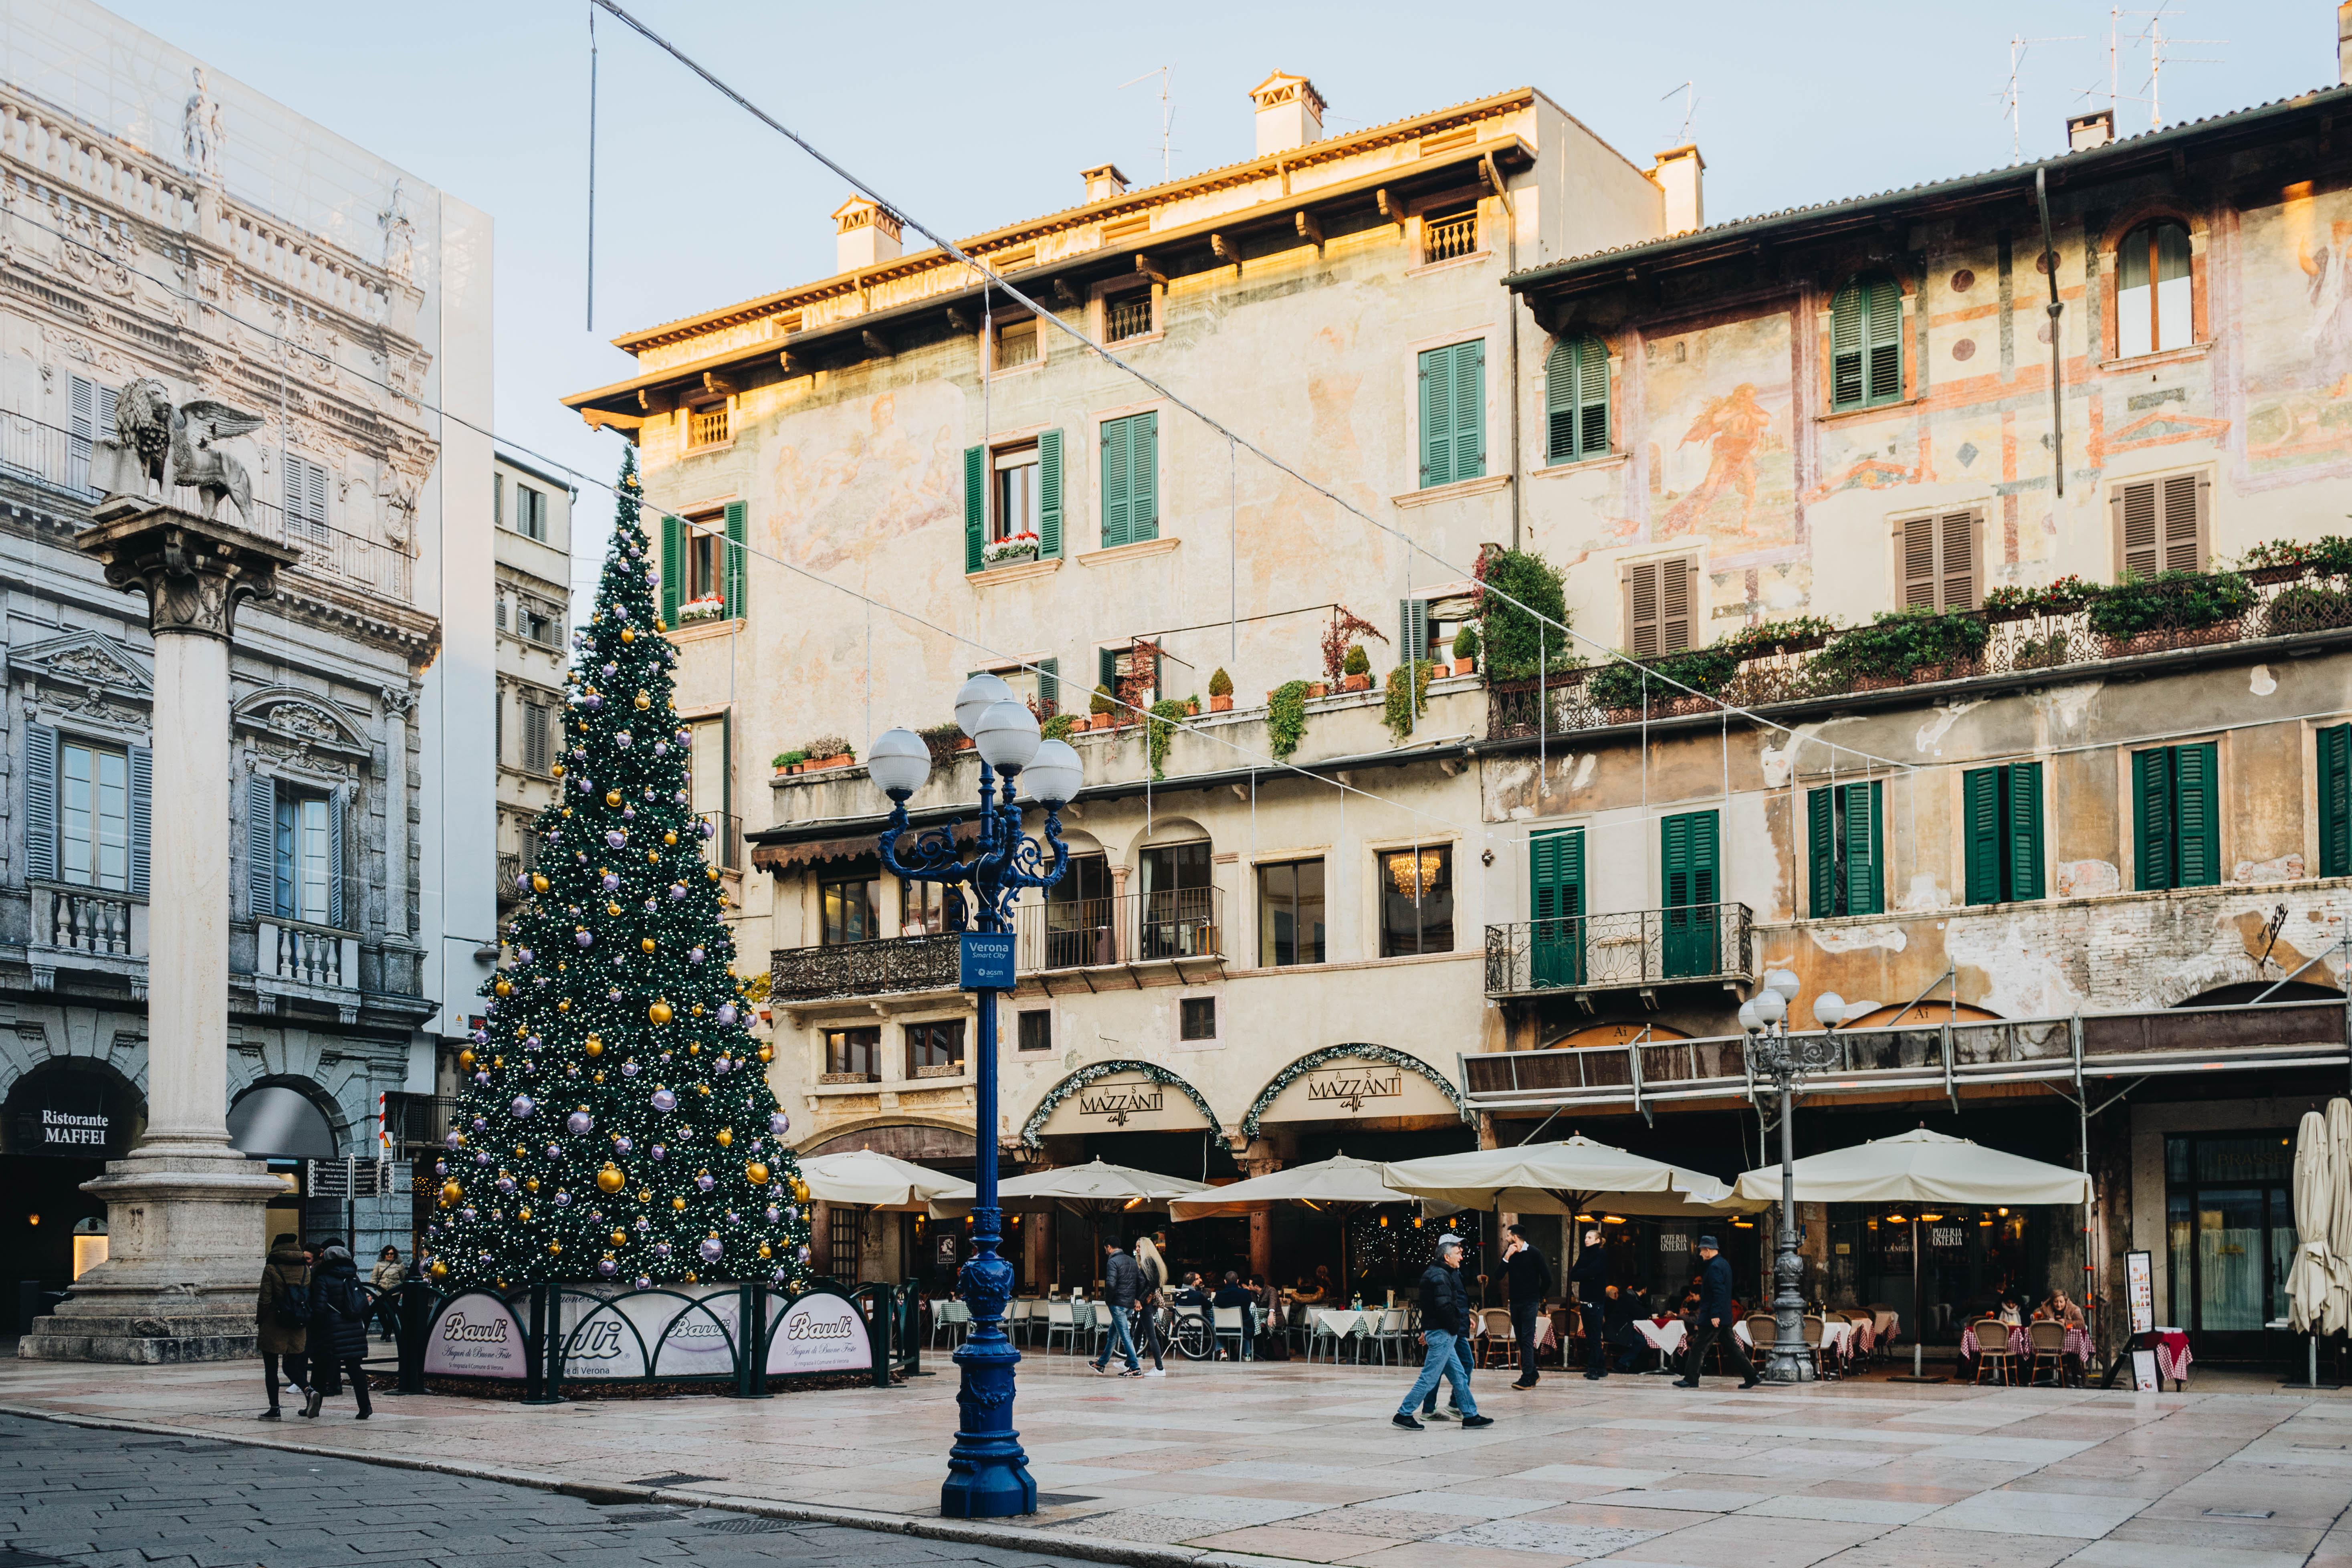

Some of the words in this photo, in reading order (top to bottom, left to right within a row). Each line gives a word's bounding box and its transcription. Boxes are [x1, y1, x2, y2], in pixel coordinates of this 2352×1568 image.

[969, 942, 1009, 952] Verona
[1914, 1007, 1929, 1019] Ai
[1613, 1026, 1627, 1037] Ai
[1308, 1068, 1401, 1082] CASA
[1079, 1084, 1163, 1097] CASA
[1308, 1078, 1401, 1098] MAZZANTI
[1080, 1093, 1163, 1112] MAZZANTI
[42, 1110, 109, 1126] Ristorante
[45, 1127, 106, 1145] MAFFEI
[1660, 1234, 1687, 1243] PIZZERIA
[1933, 1228, 1962, 1237] PIZZERIA
[1660, 1242, 1687, 1251] OSTERIA
[1933, 1236, 1962, 1246] OSTERIA
[443, 1312, 508, 1343] Bauli
[787, 1312, 852, 1340] Bauli
[442, 1344, 465, 1361] Auguri
[465, 1348, 472, 1357] di
[472, 1346, 495, 1358] Buone
[495, 1347, 512, 1359] Feste
[786, 1343, 810, 1359] Auguri
[818, 1343, 840, 1354] Buone
[840, 1342, 856, 1353] Feste
[572, 1366, 579, 1374] di
[581, 1366, 610, 1374] Verona
